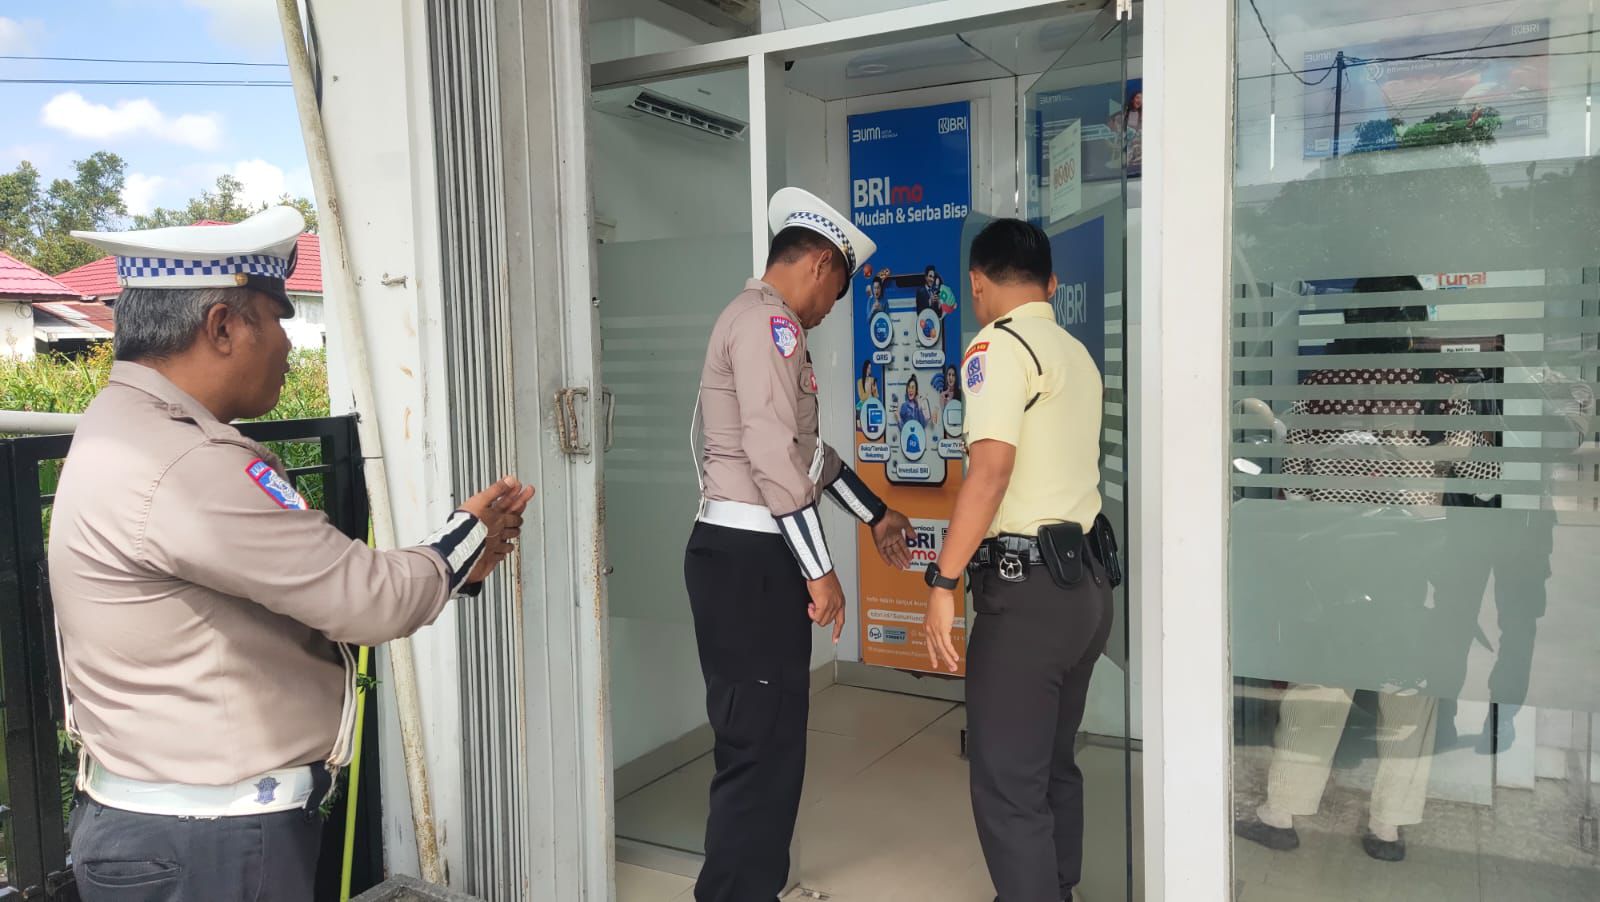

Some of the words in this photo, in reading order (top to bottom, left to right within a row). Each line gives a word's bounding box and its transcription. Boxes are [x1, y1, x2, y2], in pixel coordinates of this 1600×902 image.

[949, 116, 967, 131] BRI
[854, 209, 894, 226] Mudah
[895, 207, 906, 223] &
[907, 204, 941, 222] Serba
[943, 202, 968, 219] Bisa
[1066, 281, 1087, 325] BRI
[967, 371, 984, 388] BRI
[905, 532, 935, 549] BRI
[911, 550, 937, 560] mo
